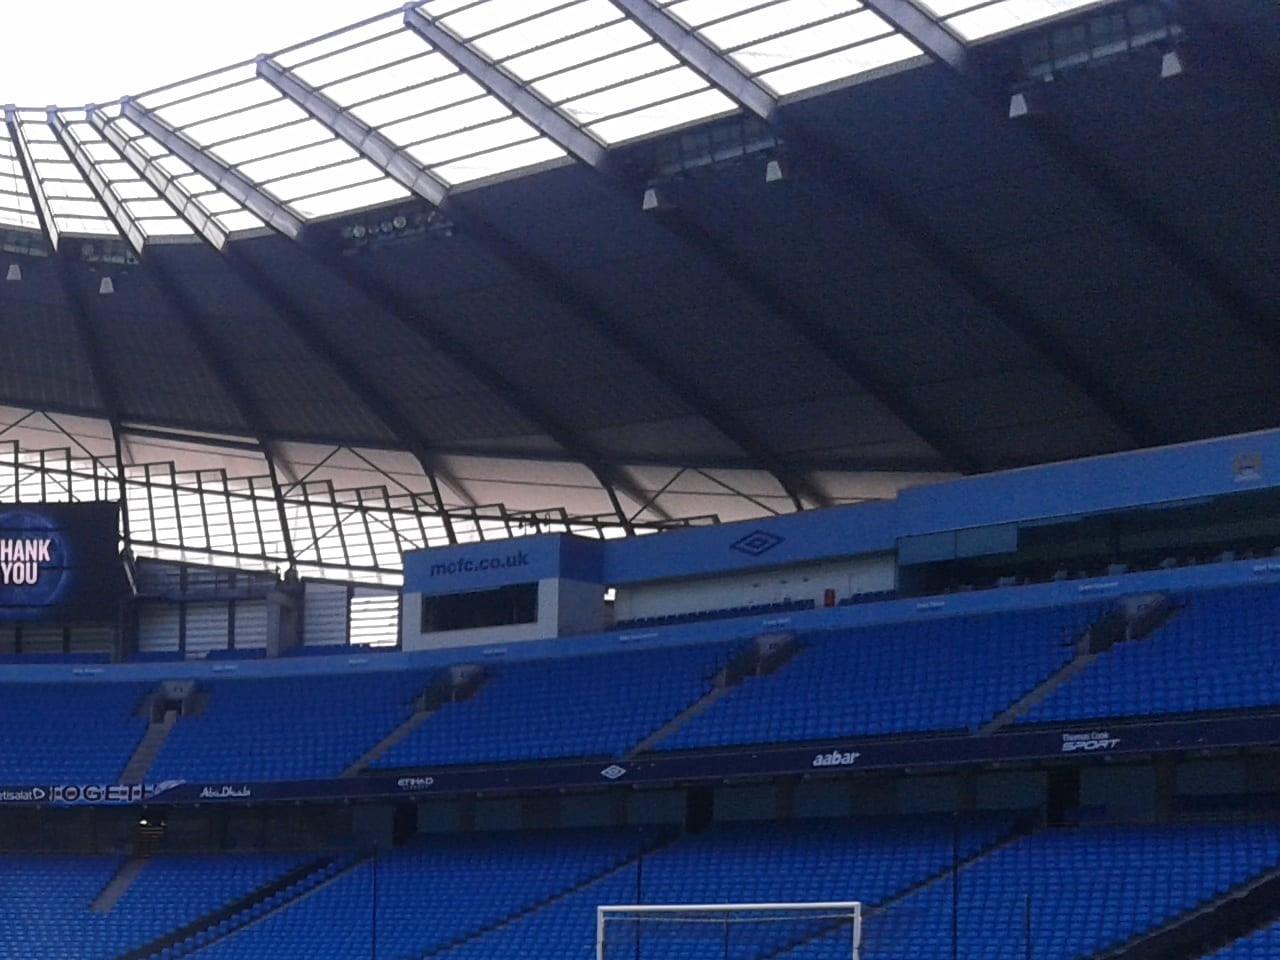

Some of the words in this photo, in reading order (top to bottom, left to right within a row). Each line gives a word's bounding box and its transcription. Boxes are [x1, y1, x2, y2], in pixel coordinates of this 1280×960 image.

[430, 551, 529, 577] mcfc.co.uk
[1, 562, 39, 585] YOU
[1062, 739, 1121, 752] SPORT
[812, 749, 861, 767] aabar
[397, 777, 434, 786] ETIHAD
